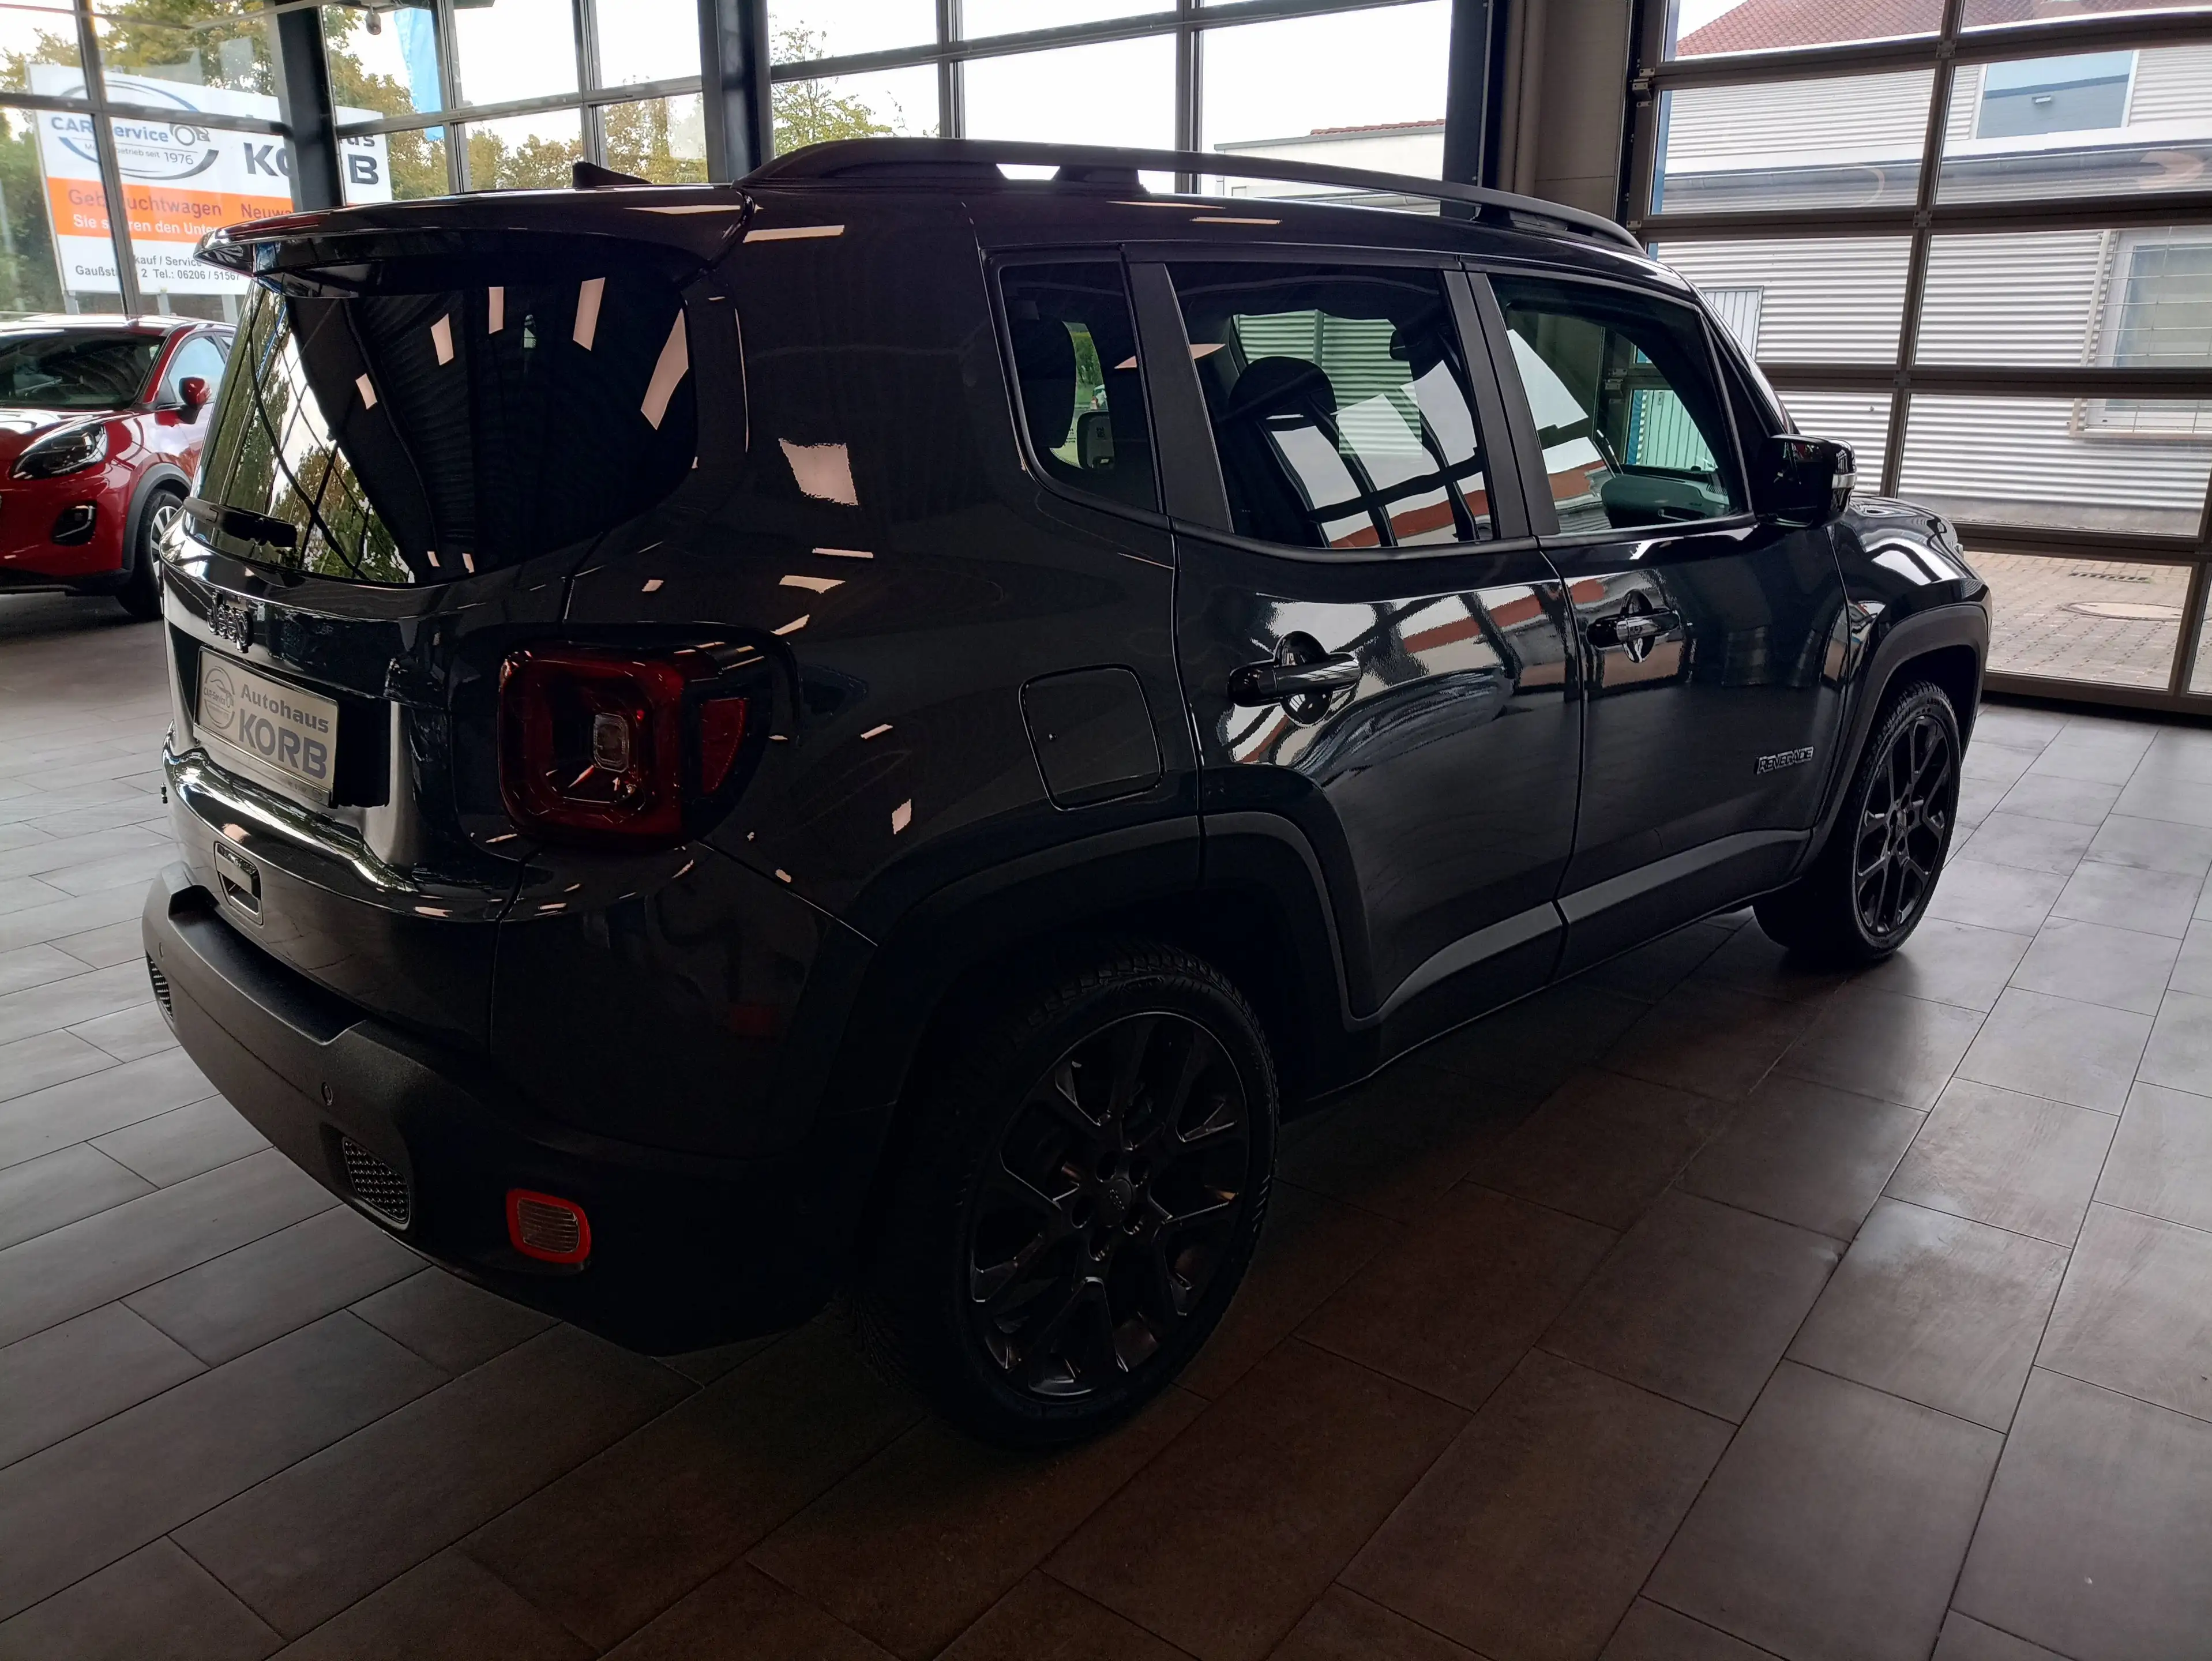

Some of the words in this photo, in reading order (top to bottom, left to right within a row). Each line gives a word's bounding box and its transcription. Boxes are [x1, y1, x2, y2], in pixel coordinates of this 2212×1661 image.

[164, 152, 194, 166] 1976
[73, 213, 97, 228] Sie
[155, 220, 180, 234] den
[166, 256, 201, 267] Service
[153, 269, 174, 279] Tel.:
[177, 270, 205, 280] 06206
[208, 271, 211, 280] /
[241, 683, 330, 734] Autohaus
[239, 708, 328, 779] KORB
[1755, 746, 1815, 775] RENEGADE
